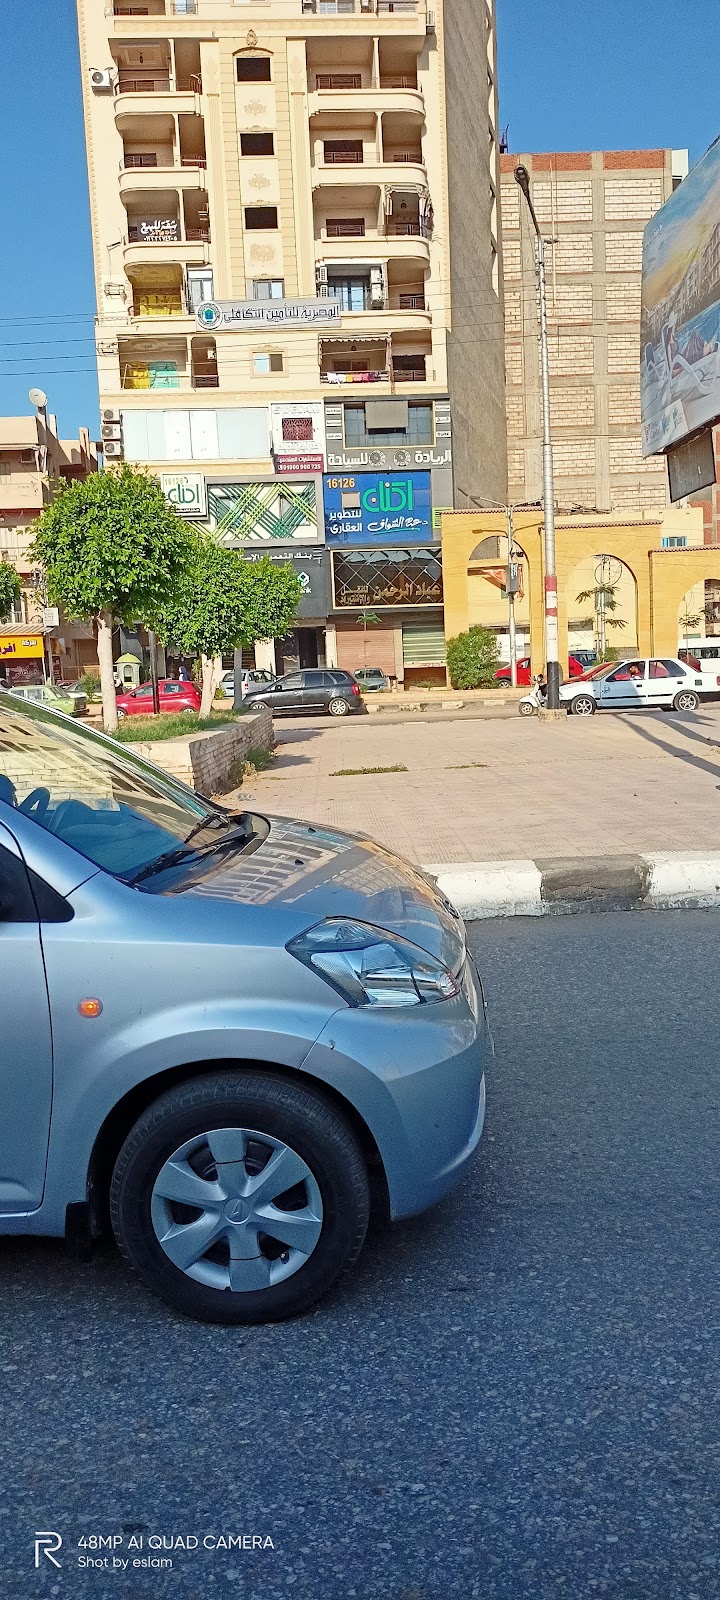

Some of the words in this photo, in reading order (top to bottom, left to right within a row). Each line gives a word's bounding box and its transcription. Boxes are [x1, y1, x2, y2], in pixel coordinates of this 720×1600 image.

[140, 220, 161, 235] للبيع
[160, 220, 178, 231] شقة
[266, 302, 299, 322] للتأمين
[301, 304, 339, 320] المصرية
[327, 453, 368, 468] للسياحة
[414, 450, 451, 465] الريادة
[326, 478, 355, 488] 16126
[329, 509, 362, 521] للتطوير
[293, 552, 312, 560] بنك
